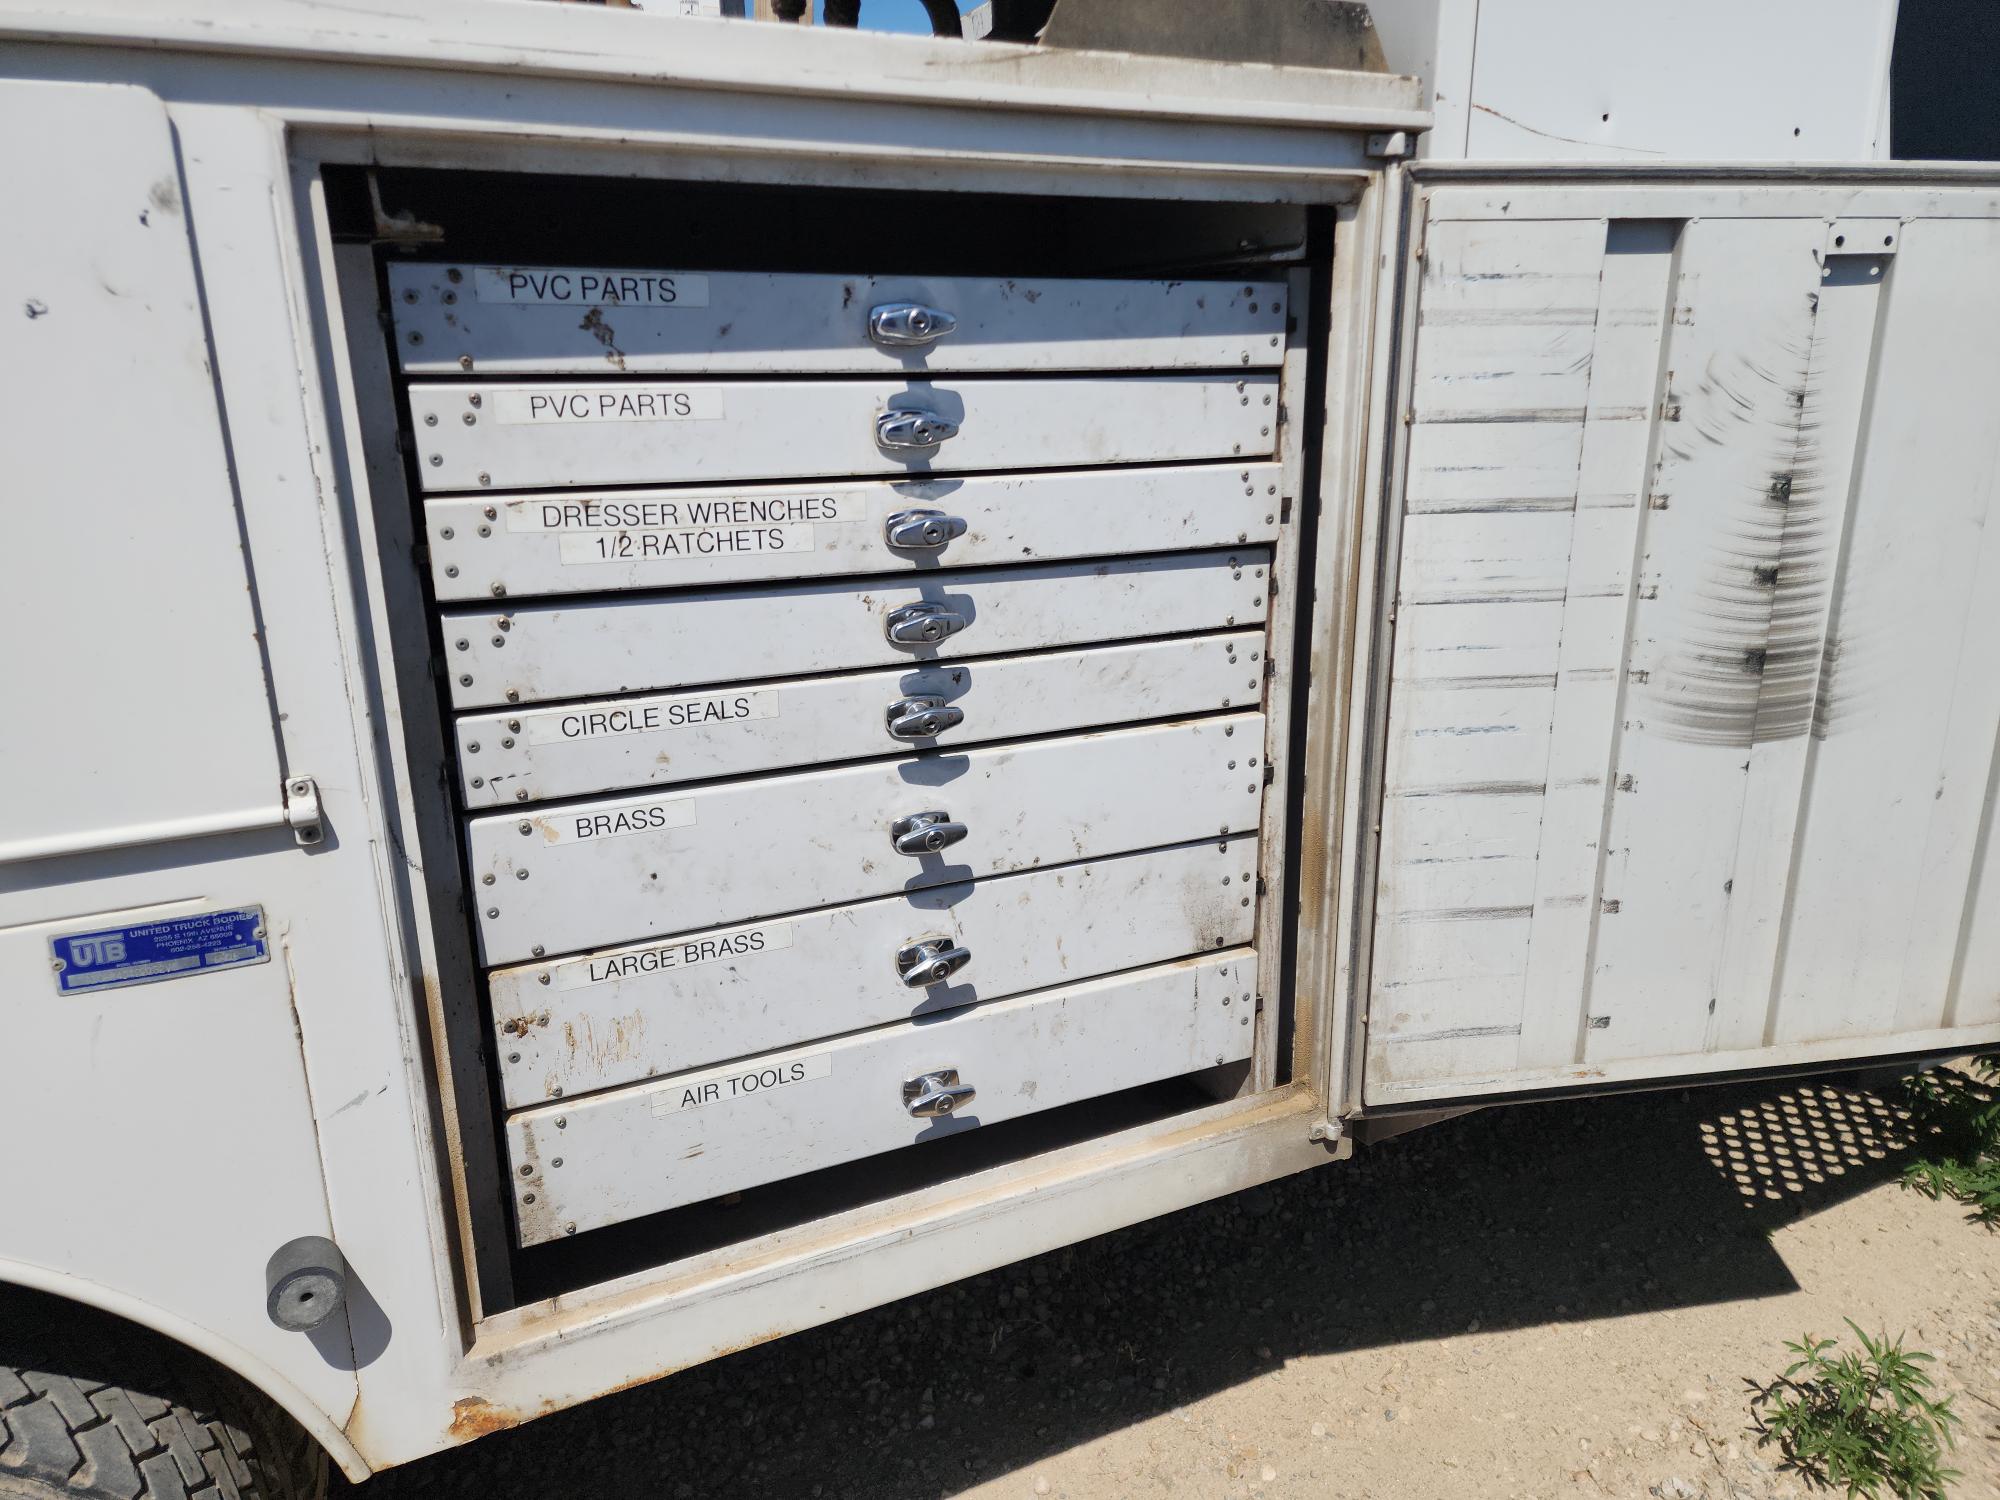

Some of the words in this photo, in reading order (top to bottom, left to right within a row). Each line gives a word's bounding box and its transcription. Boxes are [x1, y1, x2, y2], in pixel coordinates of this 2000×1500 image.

[509, 274, 571, 300] PVC
[581, 276, 676, 302] PARTS
[530, 395, 589, 418] PVC
[599, 393, 691, 417] PARTS
[542, 504, 678, 527] DRESSER
[687, 498, 837, 523] WRENCHES
[596, 536, 633, 558] 1/2
[642, 529, 785, 556] RATCHETS
[561, 708, 660, 737] CIRCLE
[669, 698, 749, 725] SEALS
[575, 807, 666, 838] BRASS
[129, 925, 170, 938] UNITED
[174, 919, 210, 931] TRUCK
[69, 933, 127, 968] UTB
[589, 948, 676, 982] LARGE
[684, 932, 765, 963] BRASS
[681, 1083, 719, 1107] AIR
[727, 1063, 805, 1095] TOOLS
